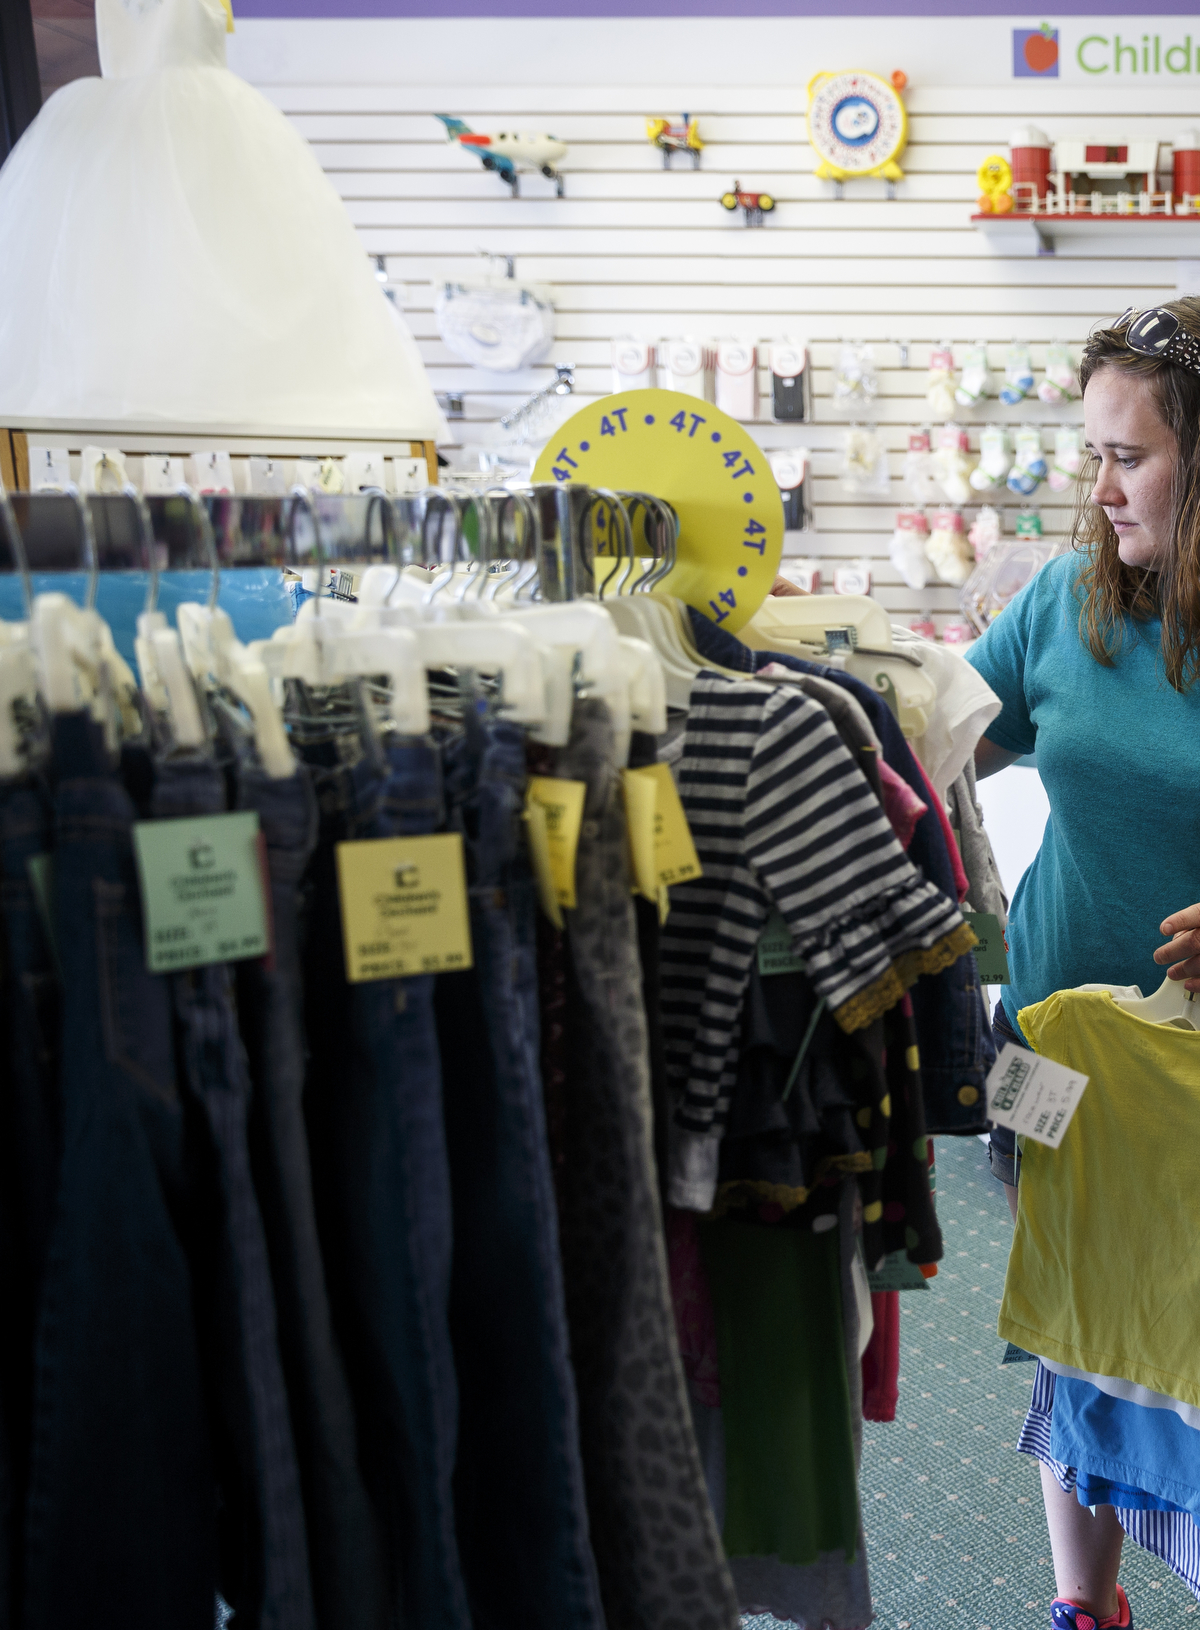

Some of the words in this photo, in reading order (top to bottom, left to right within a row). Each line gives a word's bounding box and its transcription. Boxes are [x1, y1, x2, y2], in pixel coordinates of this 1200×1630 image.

[600, 407, 628, 437] 4T
[669, 410, 707, 438] 4T
[722, 450, 755, 480] 4T
[742, 518, 767, 556] 4T
[709, 588, 737, 624] 4T
[980, 974, 1004, 982] $2.99
[1034, 1109, 1052, 1134] SIZE:
[1046, 1107, 1067, 1140] PRICE:
